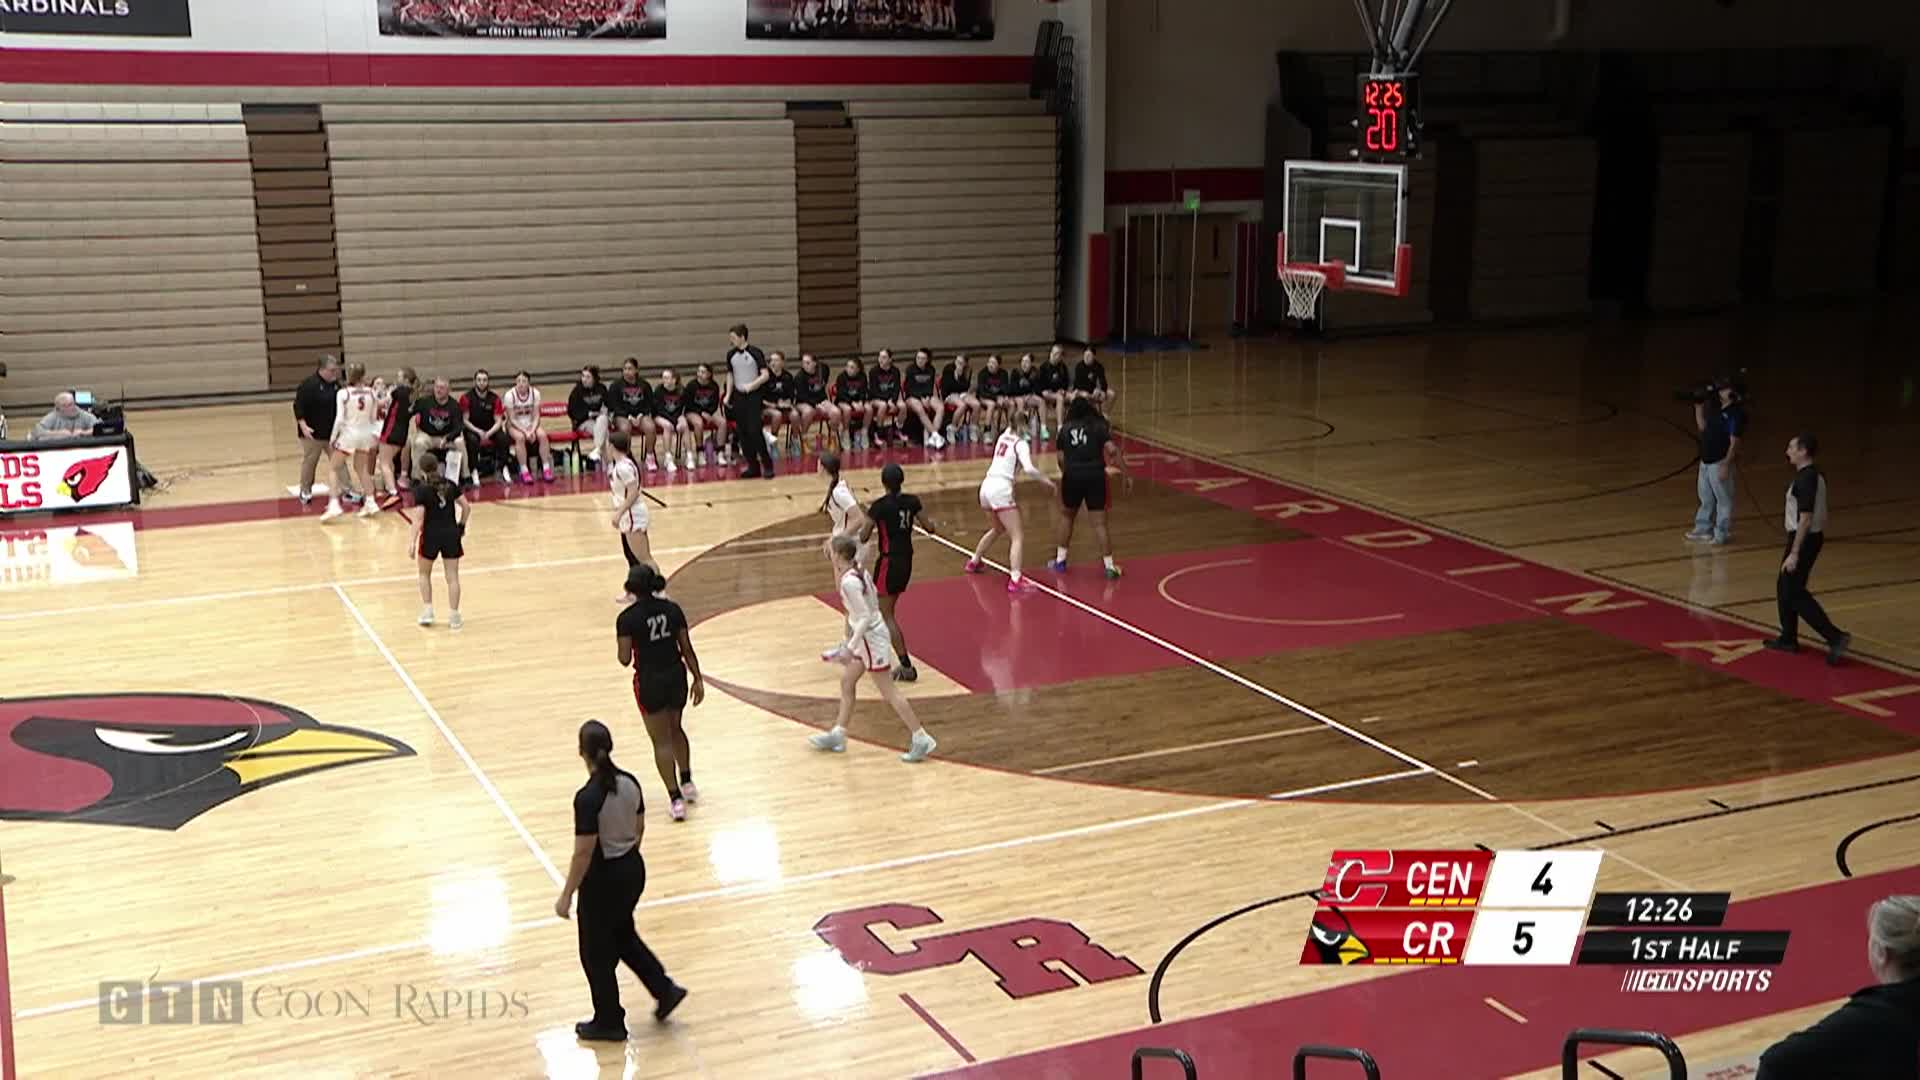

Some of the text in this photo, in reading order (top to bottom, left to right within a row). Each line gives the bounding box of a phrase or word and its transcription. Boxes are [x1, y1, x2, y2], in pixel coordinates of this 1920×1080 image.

[518, 28, 537, 37] YOUR
[1365, 83, 1402, 107] 12:25
[1366, 109, 1396, 149] 20
[646, 613, 671, 641] 22
[812, 902, 1145, 999] CR
